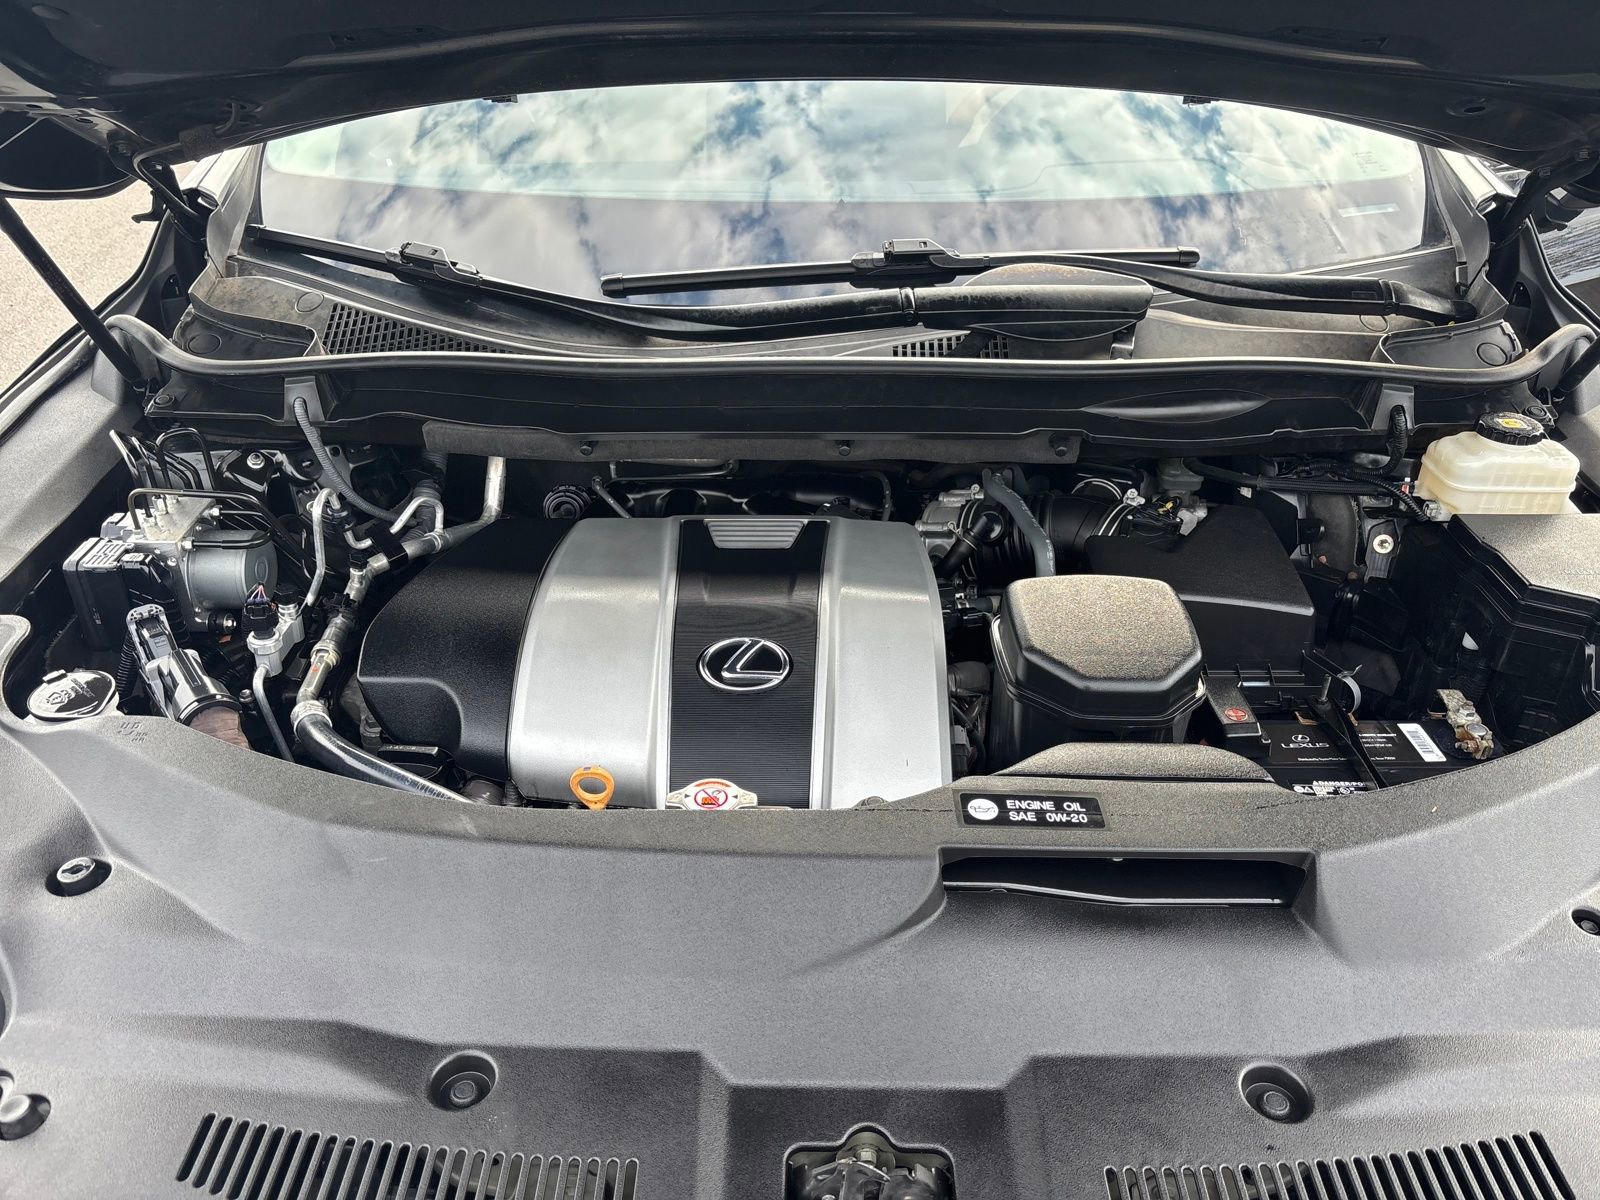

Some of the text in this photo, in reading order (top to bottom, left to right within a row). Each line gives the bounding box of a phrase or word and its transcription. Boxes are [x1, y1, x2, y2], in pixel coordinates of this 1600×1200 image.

[1006, 799, 1086, 812] ENGINE OIL
[1008, 811, 1088, 823] SAE 0W-20
